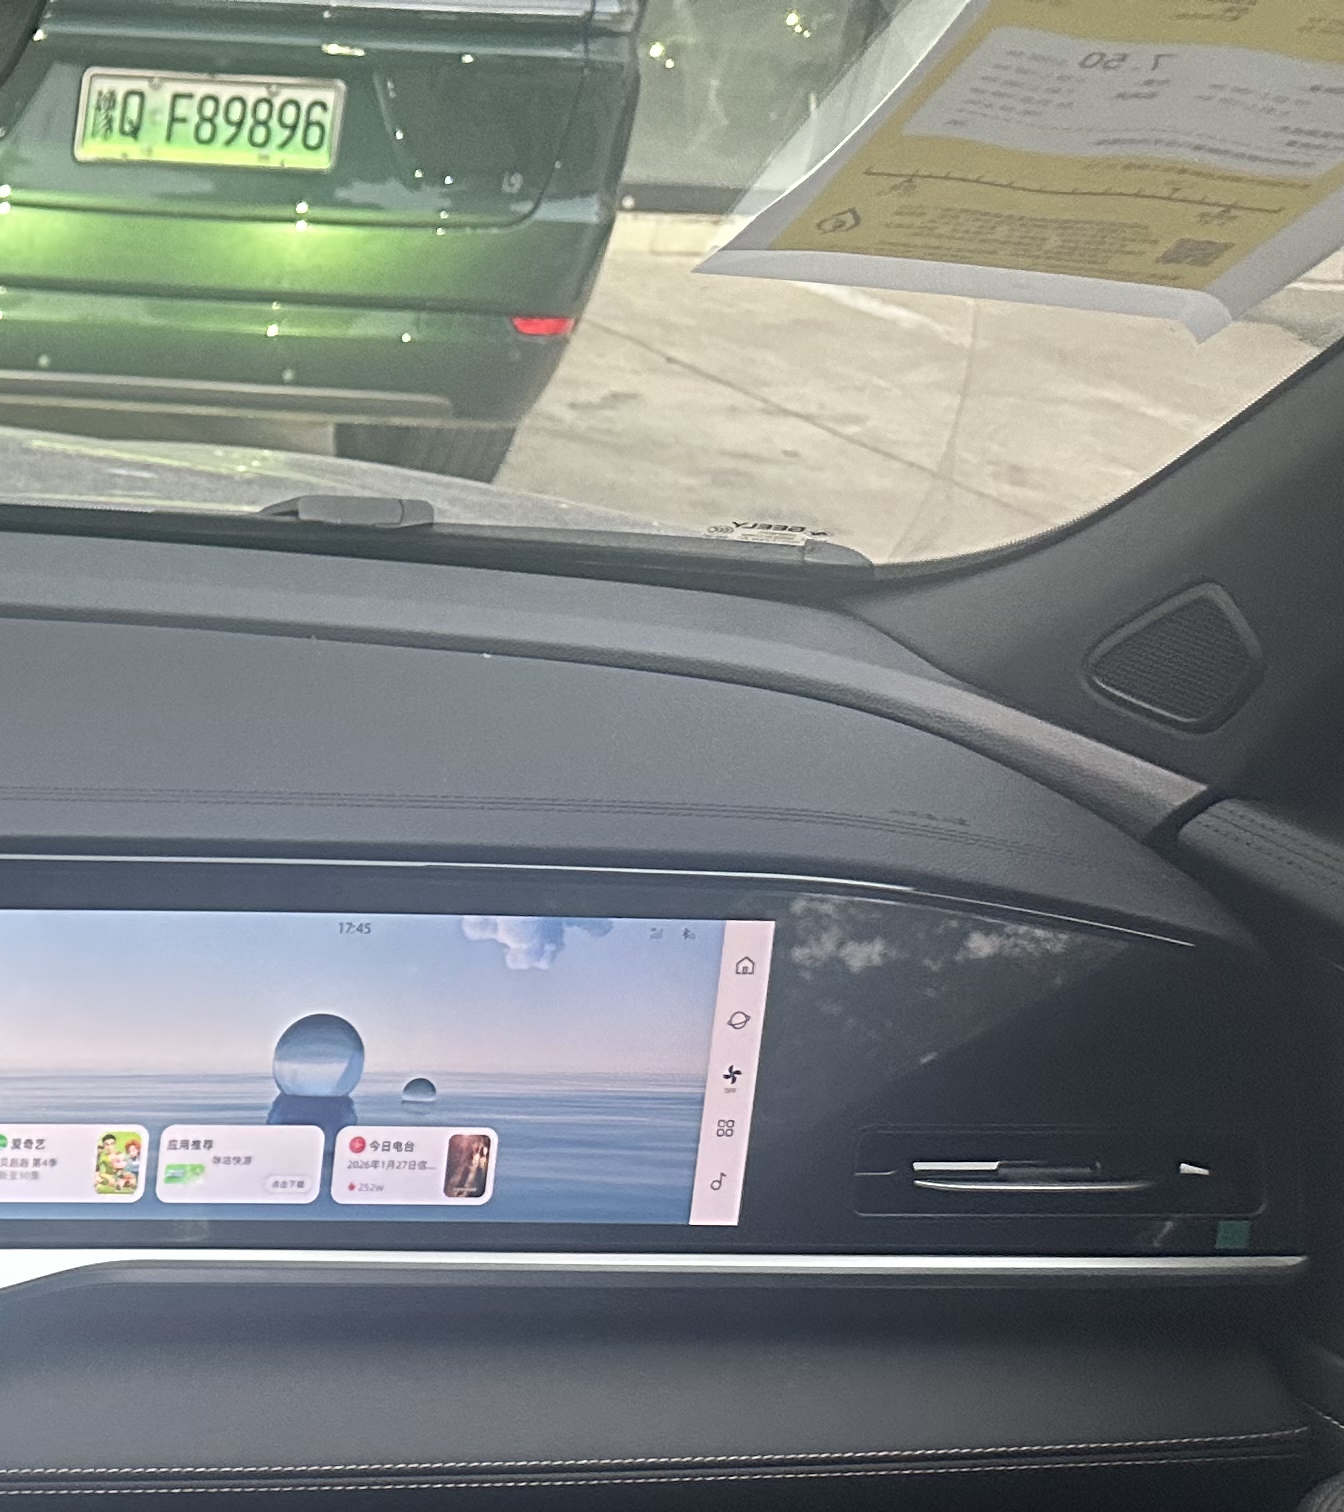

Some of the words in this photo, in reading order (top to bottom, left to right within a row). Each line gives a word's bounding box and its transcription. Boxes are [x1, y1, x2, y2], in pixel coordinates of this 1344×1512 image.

[165, 92, 329, 151] F89896
[338, 921, 371, 934] 17:45
[10, 1138, 46, 1151] 爱奇艺
[166, 1139, 214, 1151] 应用推荐
[369, 1140, 415, 1152] 今日电台
